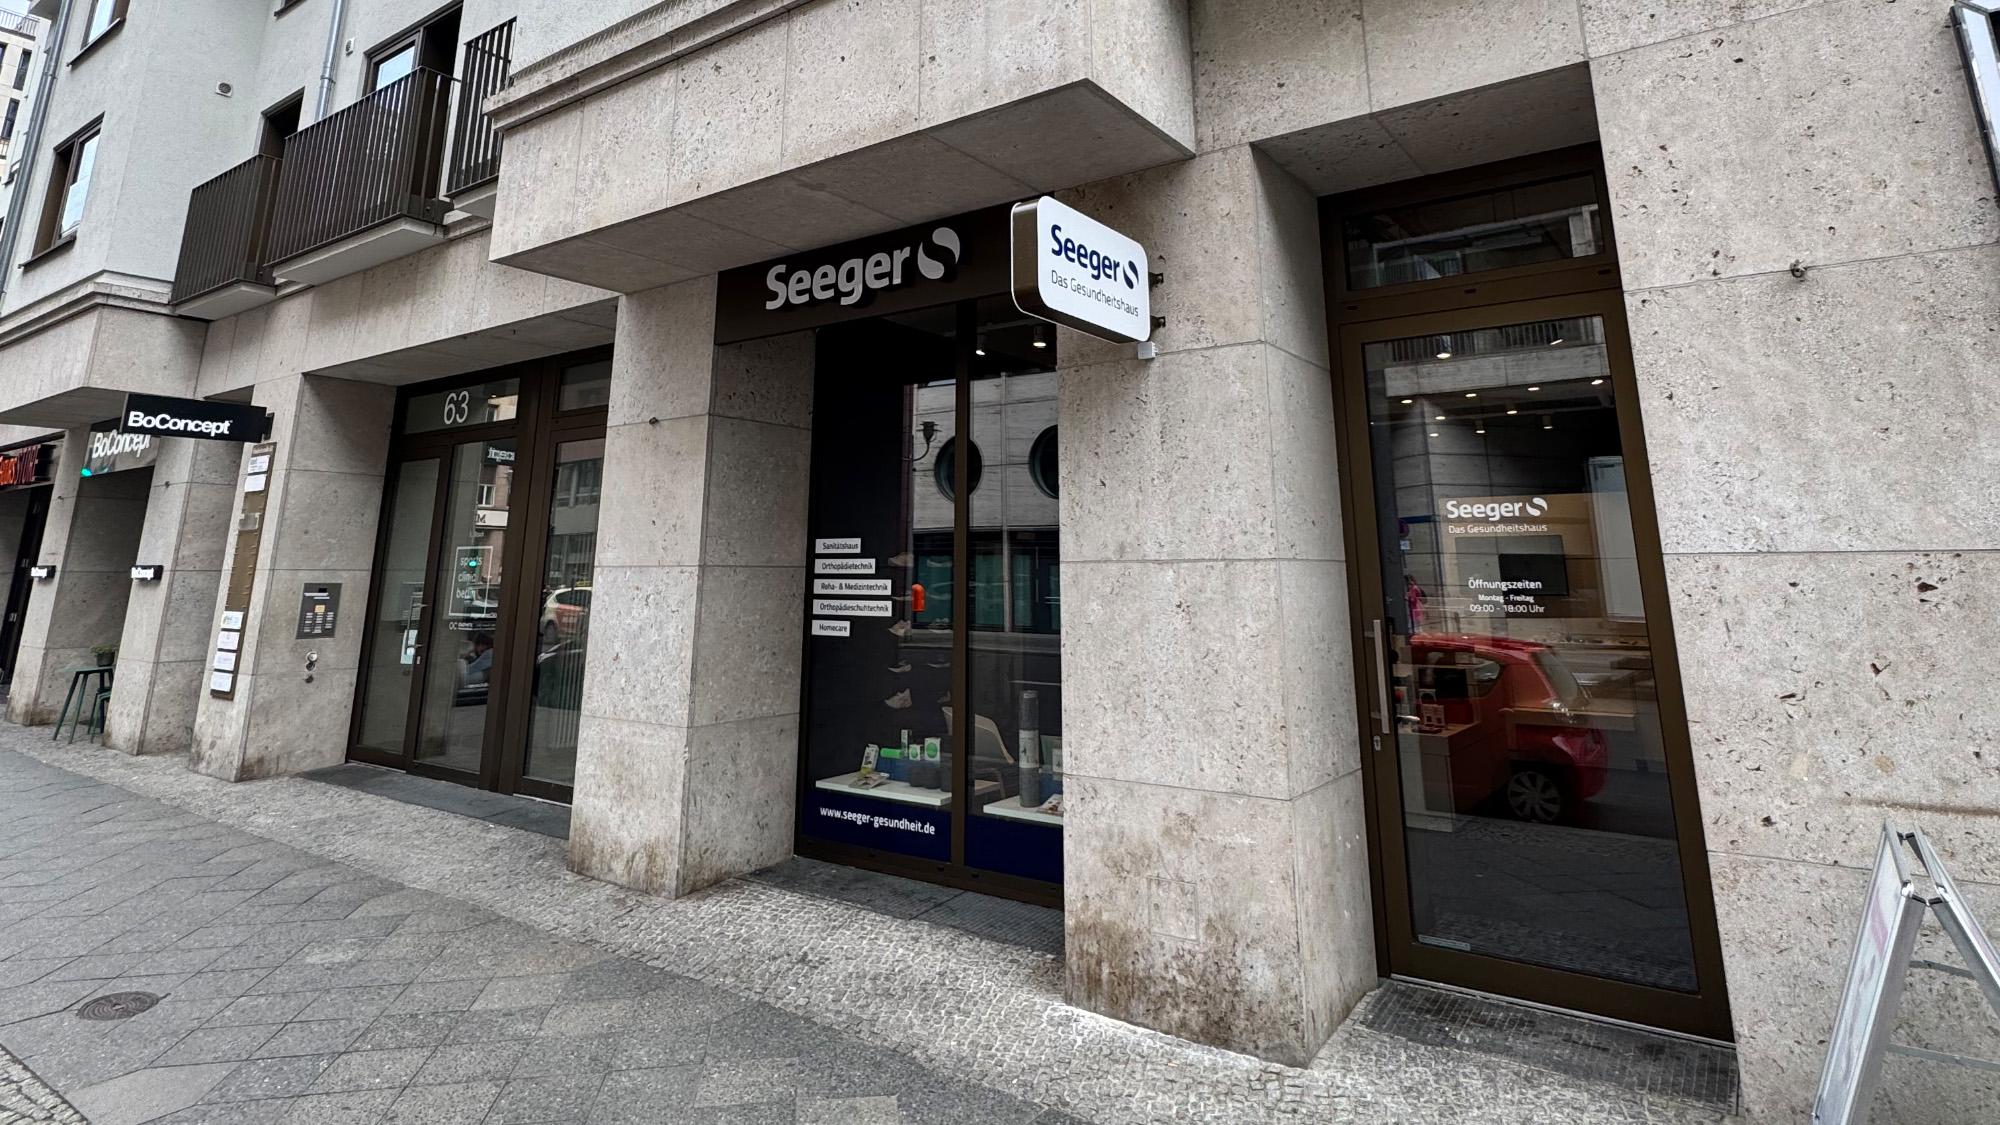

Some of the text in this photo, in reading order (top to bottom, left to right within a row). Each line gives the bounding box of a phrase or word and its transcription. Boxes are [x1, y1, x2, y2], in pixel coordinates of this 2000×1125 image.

[1051, 224, 1120, 282] Seeger
[766, 246, 910, 310] Seeger
[1051, 269, 1139, 317] Das Gesundheitshaus
[444, 391, 469, 424] 63
[128, 411, 230, 437] BoConcept
[1446, 500, 1523, 521] Seeger
[1448, 524, 1547, 534] Das Gesundheitshaus
[821, 562, 873, 571] Orthopädietechnik
[821, 582, 838, 591] Reha-
[844, 583, 888, 591] Medizintechnik
[1468, 577, 1542, 591] Öffnungszeiten
[1478, 594, 1504, 602] Montag
[1509, 594, 1534, 602] Freitag
[820, 603, 889, 612] Orthopädieschuhtechnik
[1470, 604, 1494, 612] 09:00
[1503, 604, 1528, 612] 18:00
[1529, 604, 1545, 612] Uhr
[819, 624, 848, 632] Homecare
[820, 806, 935, 835] www.seeger-gesundheit.de
